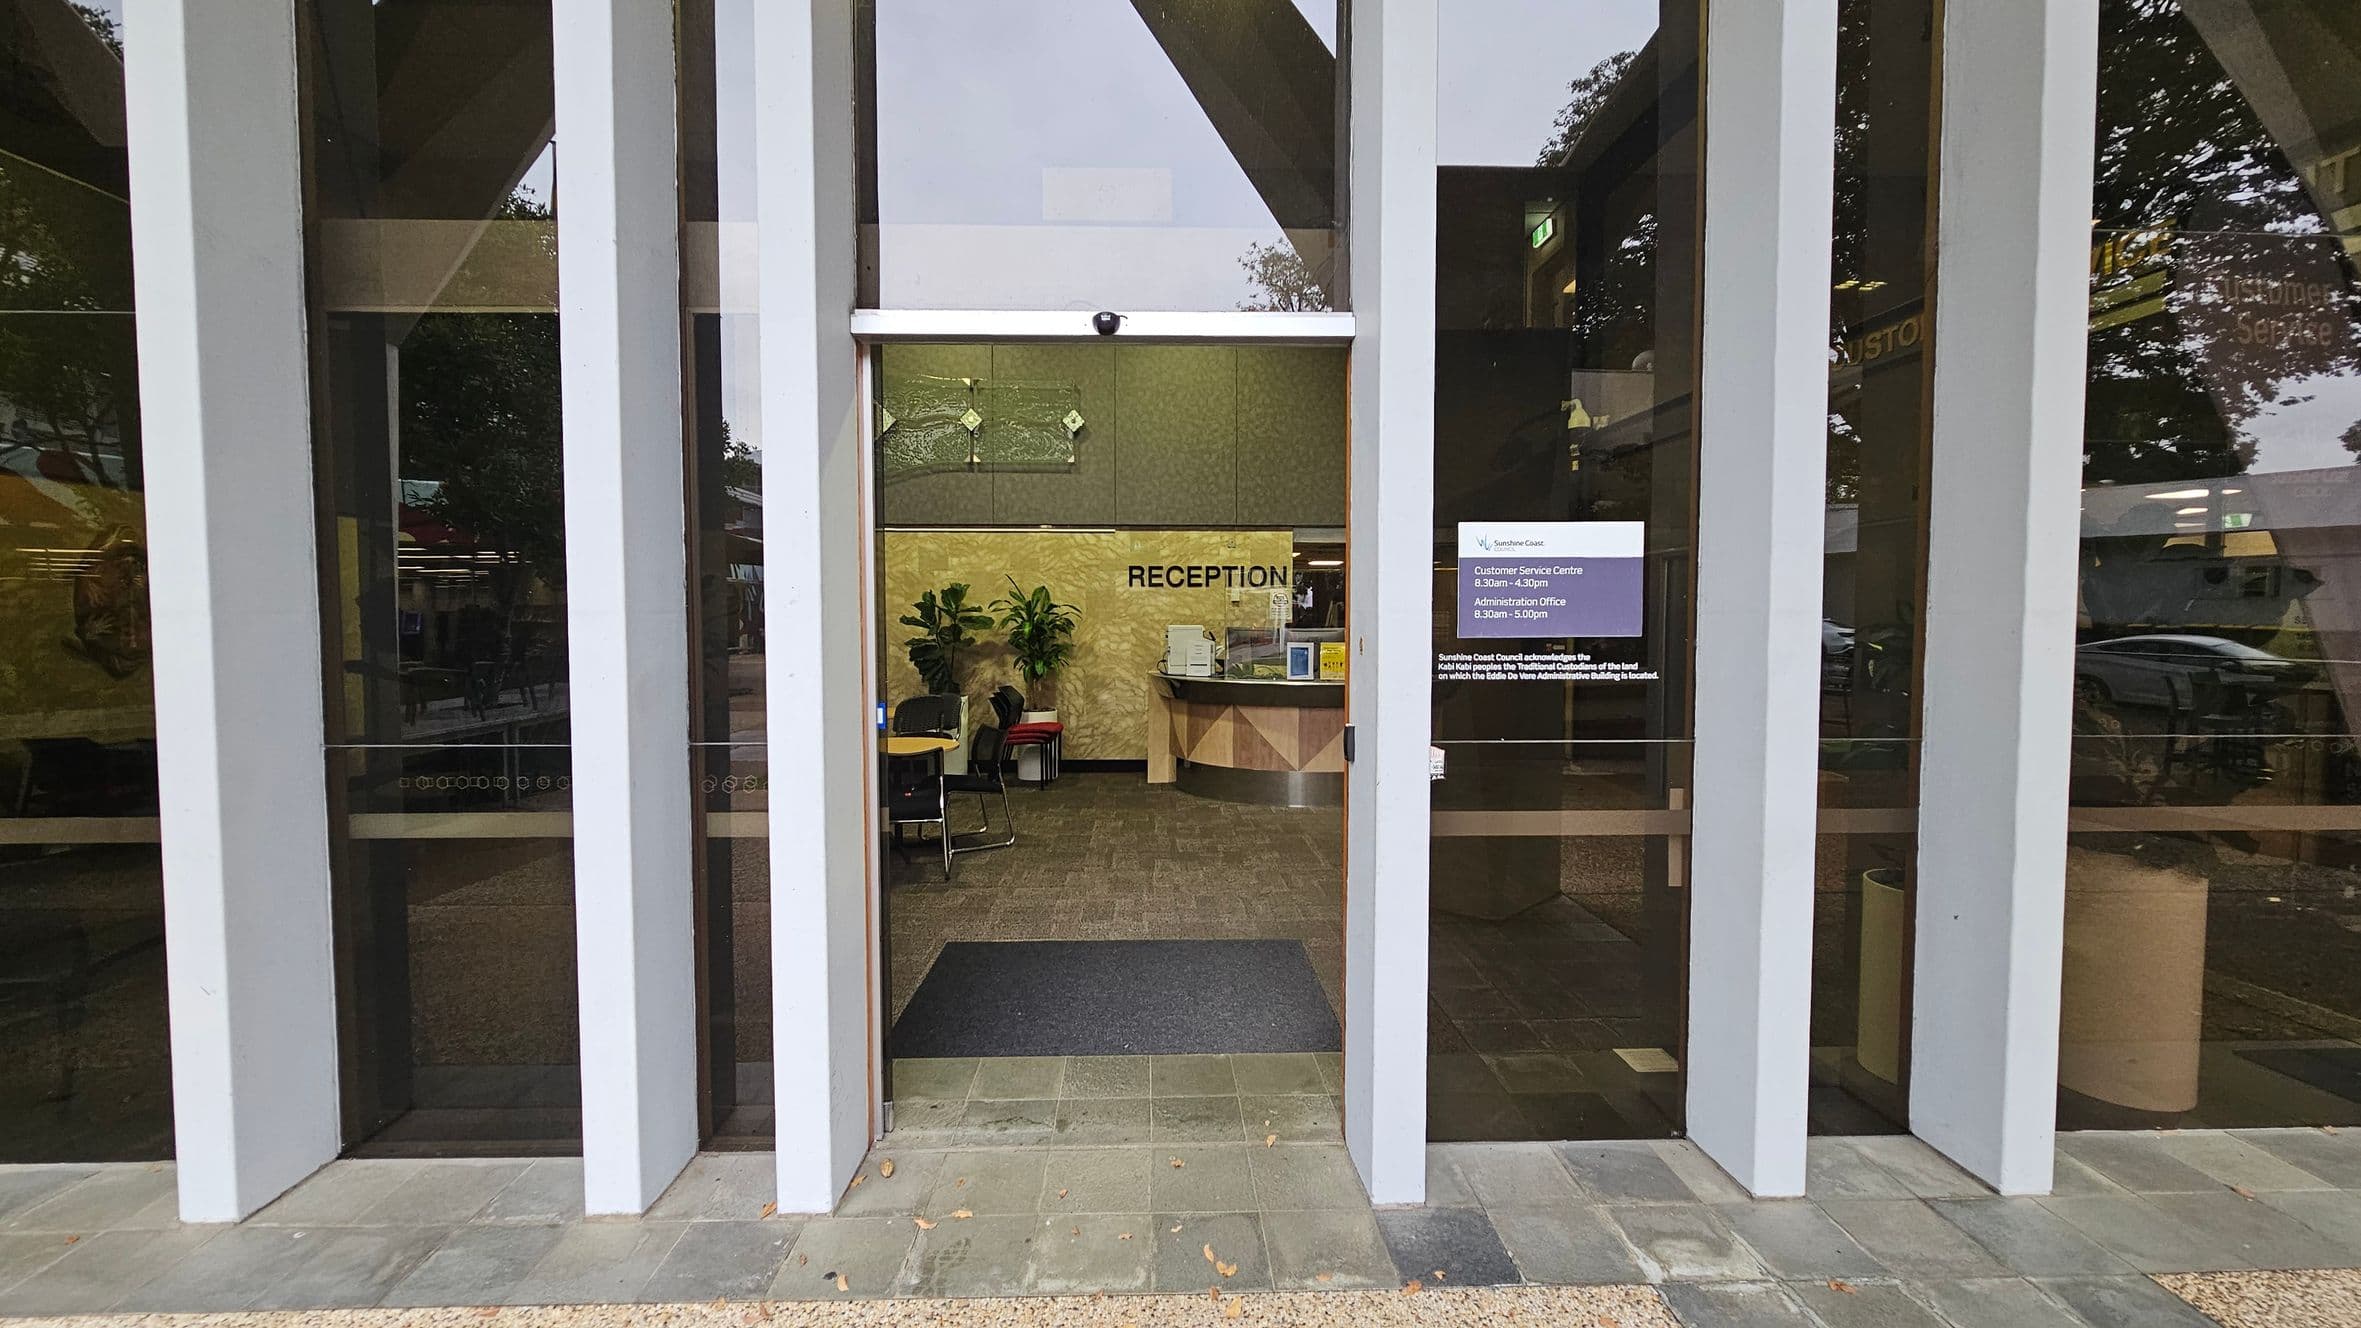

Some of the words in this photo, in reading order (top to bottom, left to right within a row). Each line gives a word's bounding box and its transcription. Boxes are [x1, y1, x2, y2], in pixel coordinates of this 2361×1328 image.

[2205, 270, 2333, 306] ustomer
[1494, 539, 1524, 547] Sunshine
[1525, 539, 1544, 547] Coast
[1474, 566, 1517, 575] Customer
[1519, 566, 1552, 575] Service
[1553, 566, 1584, 575] Centre
[1128, 565, 1288, 589] RECEPTION
[1474, 578, 1508, 588] 8.30am
[1514, 578, 1549, 590] 4.30pm
[1474, 596, 1538, 607] Administration
[1539, 596, 1567, 607] Office
[1474, 609, 1508, 619] 8.30am
[1514, 609, 1548, 621] 5.00pm
[1438, 653, 1473, 662] Sunshine
[1473, 653, 1495, 662] Coast
[1496, 653, 1523, 662] Council
[1524, 653, 1577, 663] acknowledges
[1577, 653, 1591, 662] the
[1438, 663, 1455, 671] Kabi
[1455, 663, 1472, 671] Kabi
[1472, 663, 1502, 672] peoples
[1503, 663, 1516, 671] the
[1517, 662, 1556, 671] Traditional
[1556, 662, 1597, 671] Custodians
[1598, 662, 1607, 671] of
[1608, 662, 1621, 671] the
[1621, 662, 1638, 671] land
[1449, 672, 1471, 680] which
[1472, 672, 1485, 680] the
[1486, 672, 1507, 680] Eddie
[1519, 672, 1537, 680] Vere
[1537, 672, 1591, 680] Administrative
[1591, 672, 1621, 682] Building
[1621, 672, 1628, 680] is
[1629, 671, 1659, 680] located.
